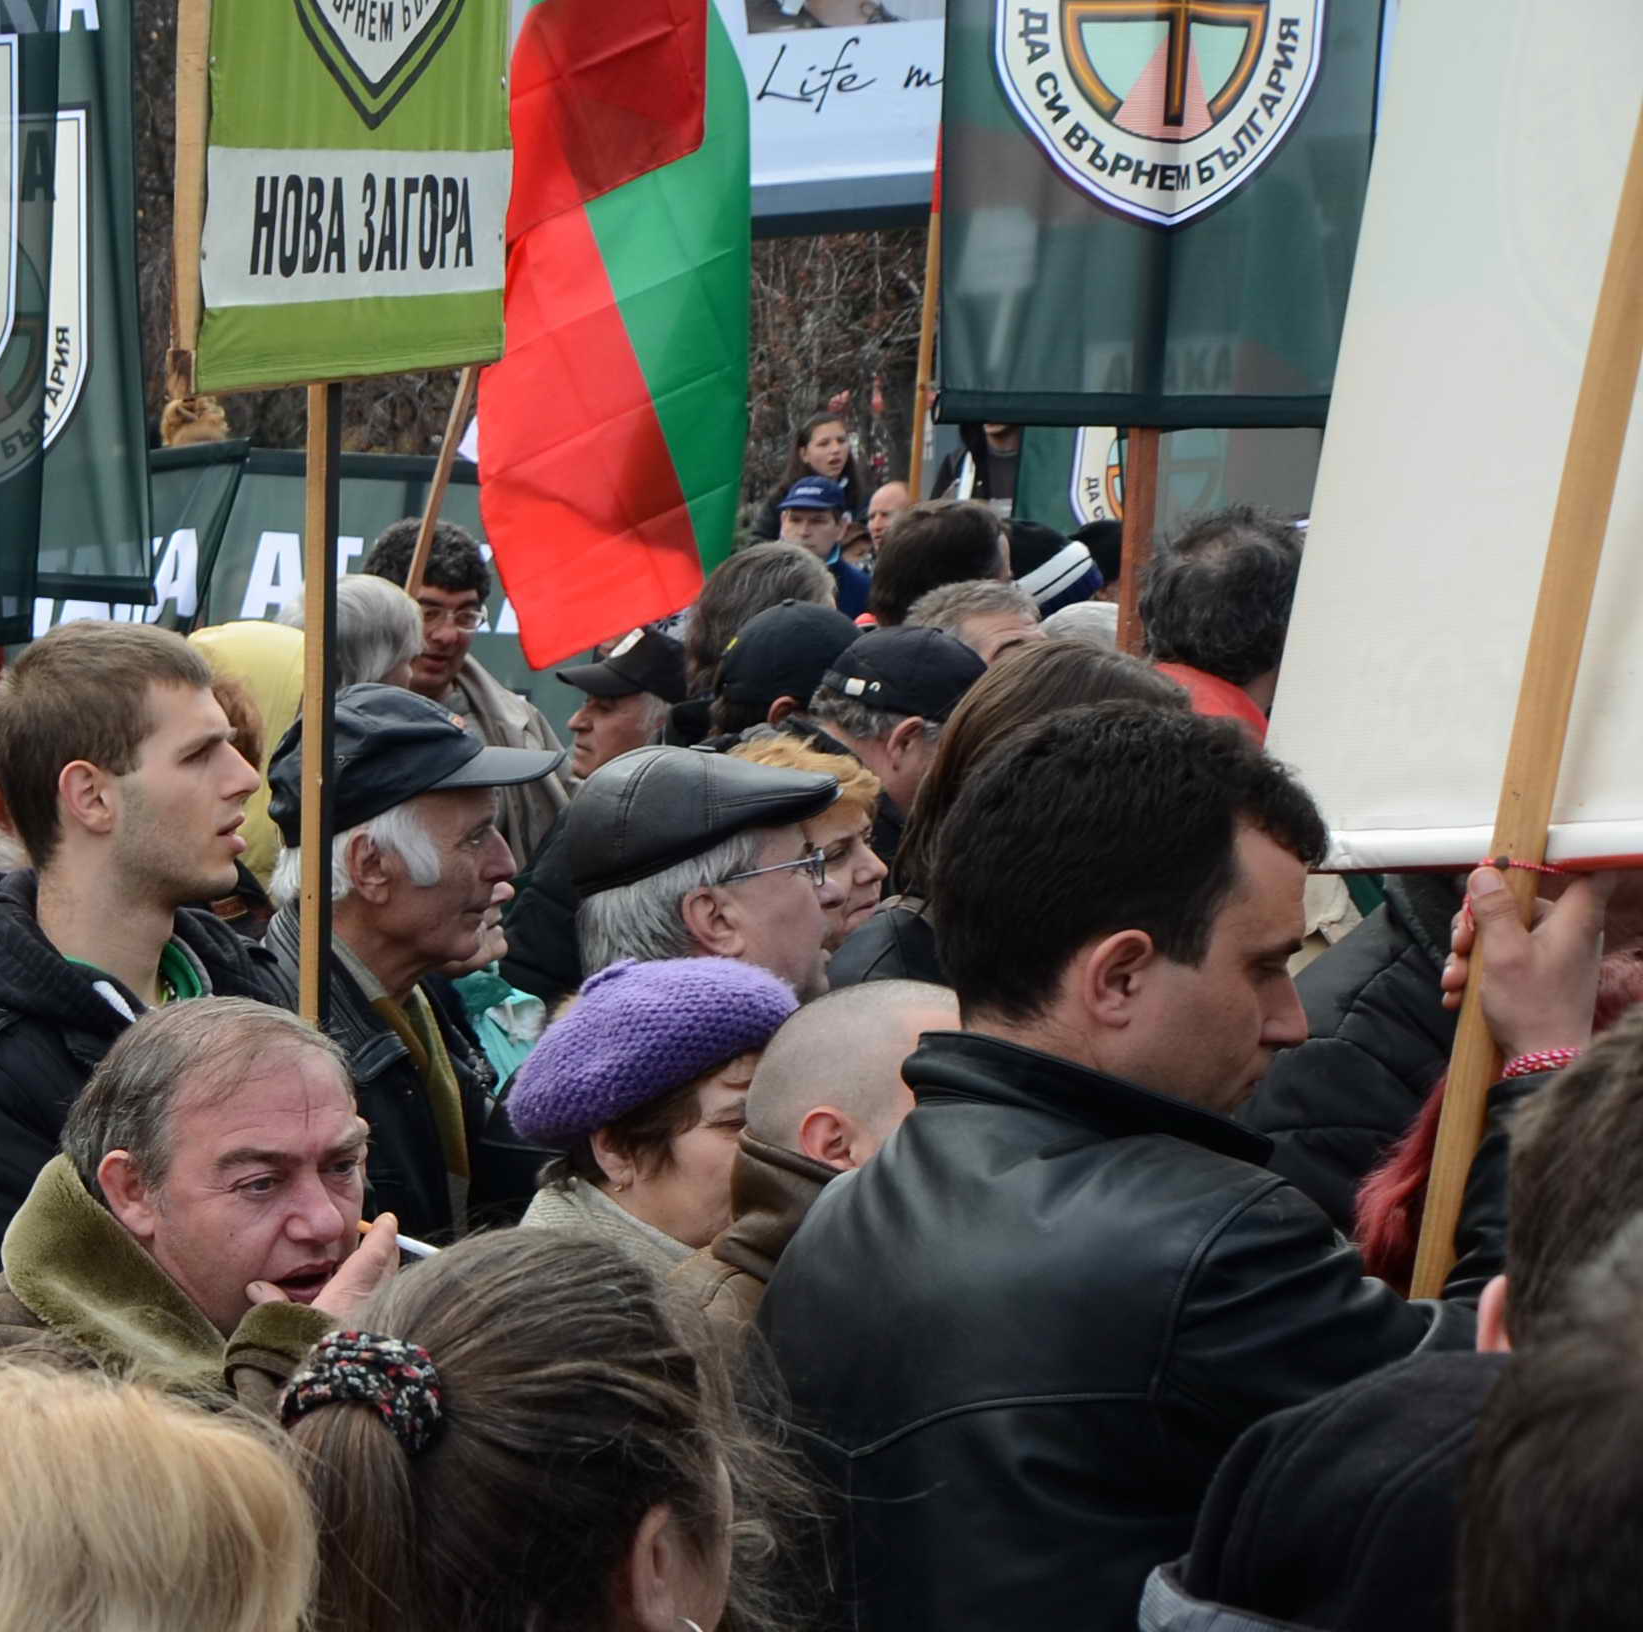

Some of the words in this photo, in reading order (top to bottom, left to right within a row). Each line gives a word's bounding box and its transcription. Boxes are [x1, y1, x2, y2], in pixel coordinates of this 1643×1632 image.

[756, 36, 877, 113] Life
[1018, 8, 1050, 65] ДА
[1035, 71, 1070, 124] СИ
[1063, 122, 1190, 191] ВЪРНЕМ
[1196, 17, 1300, 185] БЪЛГАРИЯ
[249, 174, 346, 278] НОВА
[358, 172, 474, 273] ЗАГОРА
